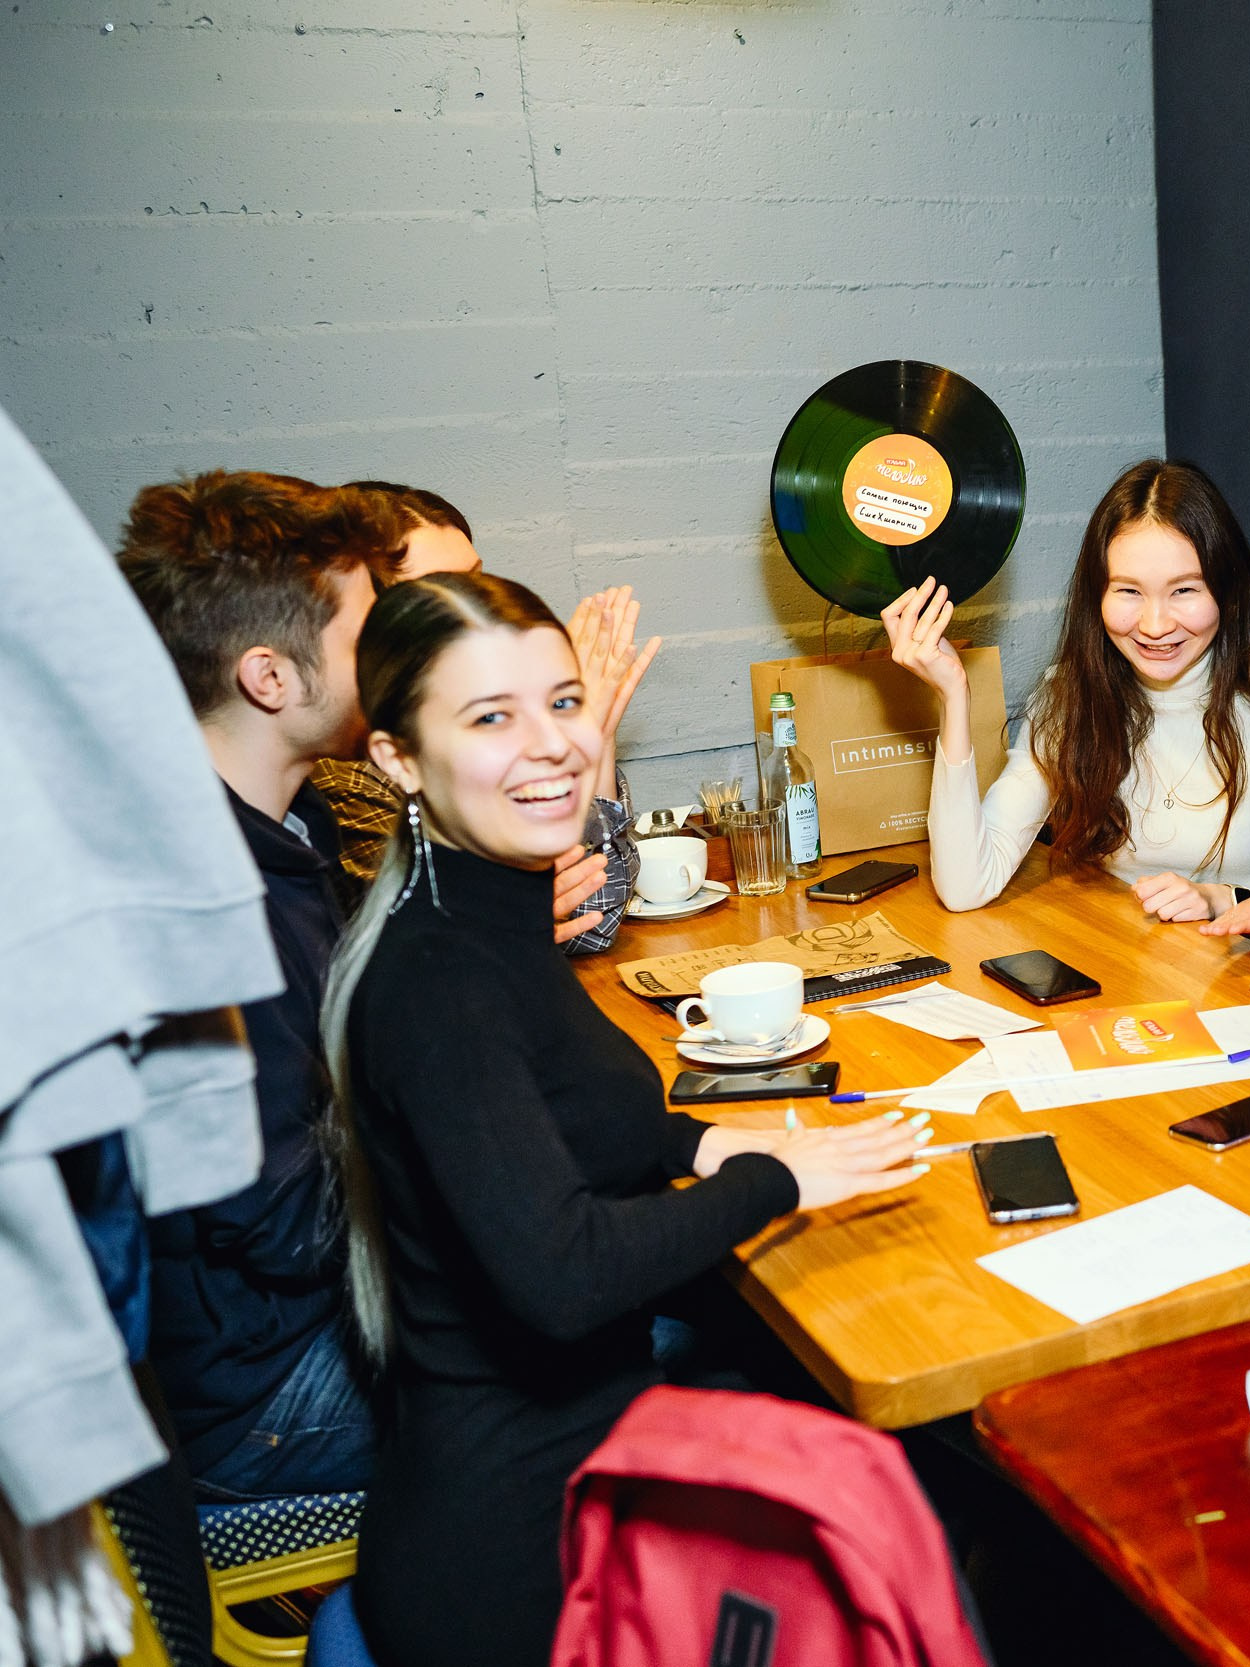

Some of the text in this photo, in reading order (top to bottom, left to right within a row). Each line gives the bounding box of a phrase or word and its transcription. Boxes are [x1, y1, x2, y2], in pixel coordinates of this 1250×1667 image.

[861, 488, 928, 511] Самые поющие
[841, 740, 937, 764] intimissi
[795, 807, 815, 817] ABRAU
